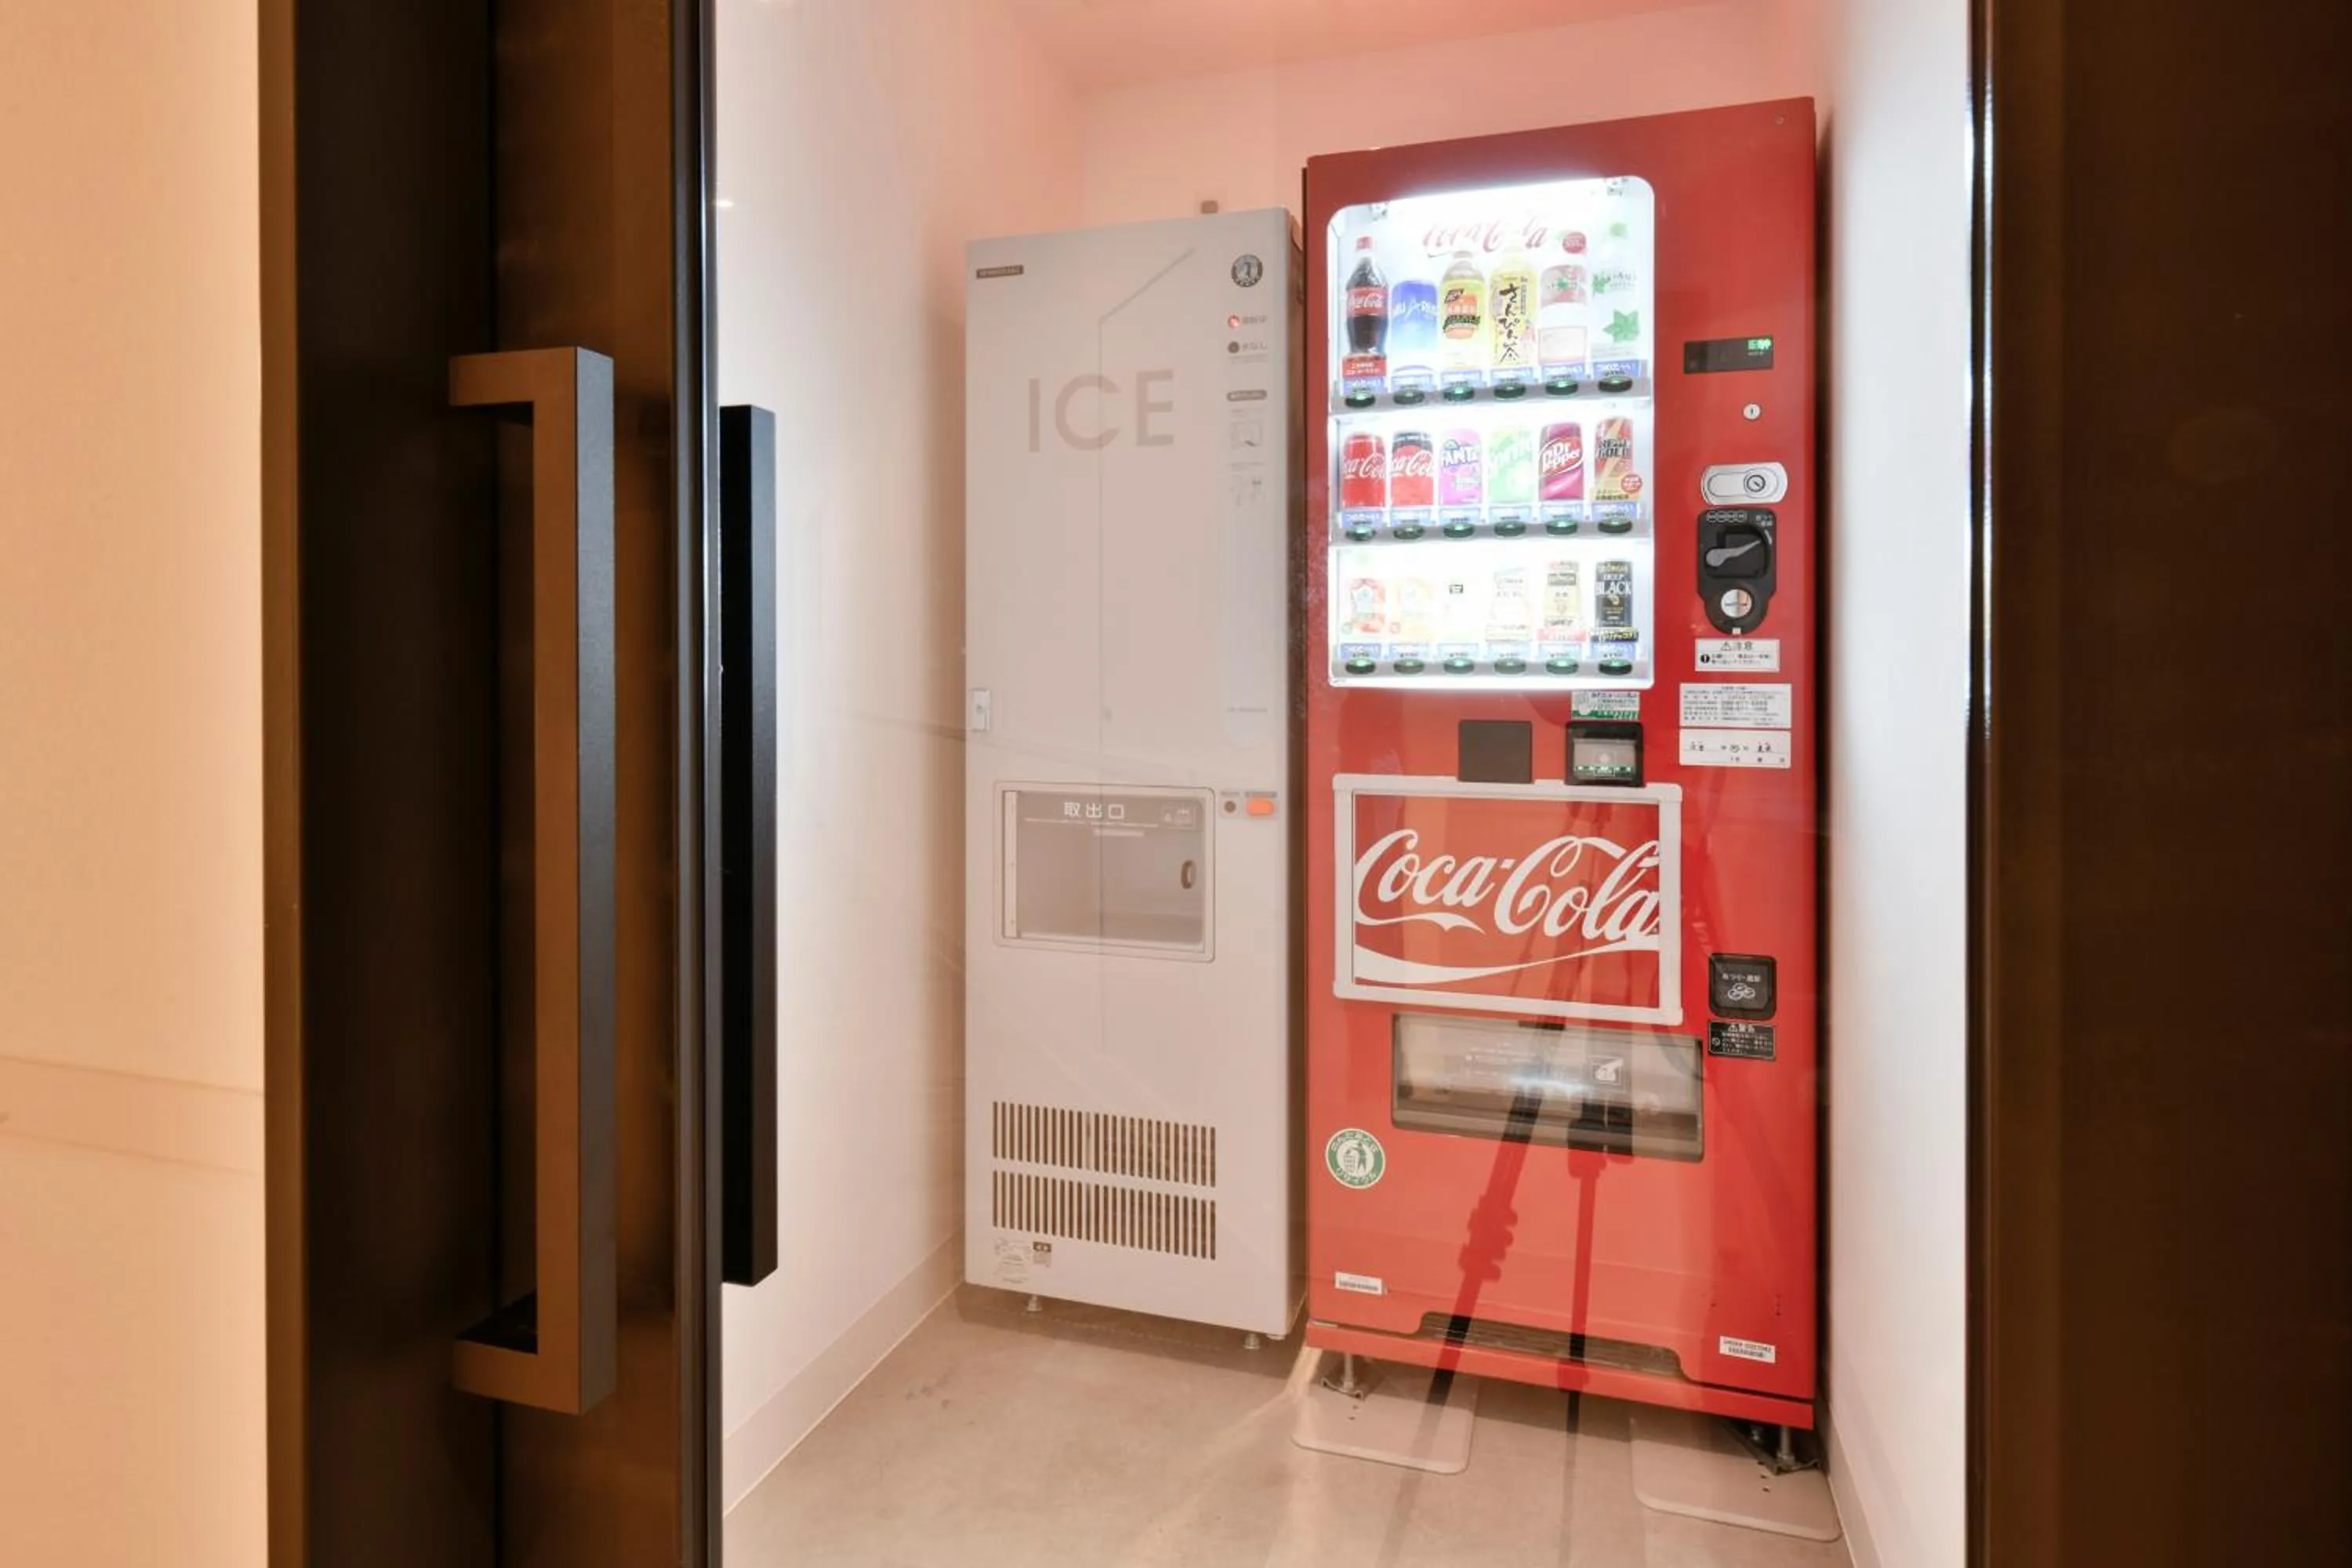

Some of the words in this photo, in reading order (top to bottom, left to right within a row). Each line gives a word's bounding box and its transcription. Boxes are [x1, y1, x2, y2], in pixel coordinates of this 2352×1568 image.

[1499, 283, 1520, 364] さんぴん茶
[1028, 369, 1174, 453] ICE
[1552, 441, 1571, 454] Dr
[1595, 581, 1632, 595] BLACK
[1064, 801, 1124, 820] 取出口
[1355, 829, 1660, 941] Coca-Cola
